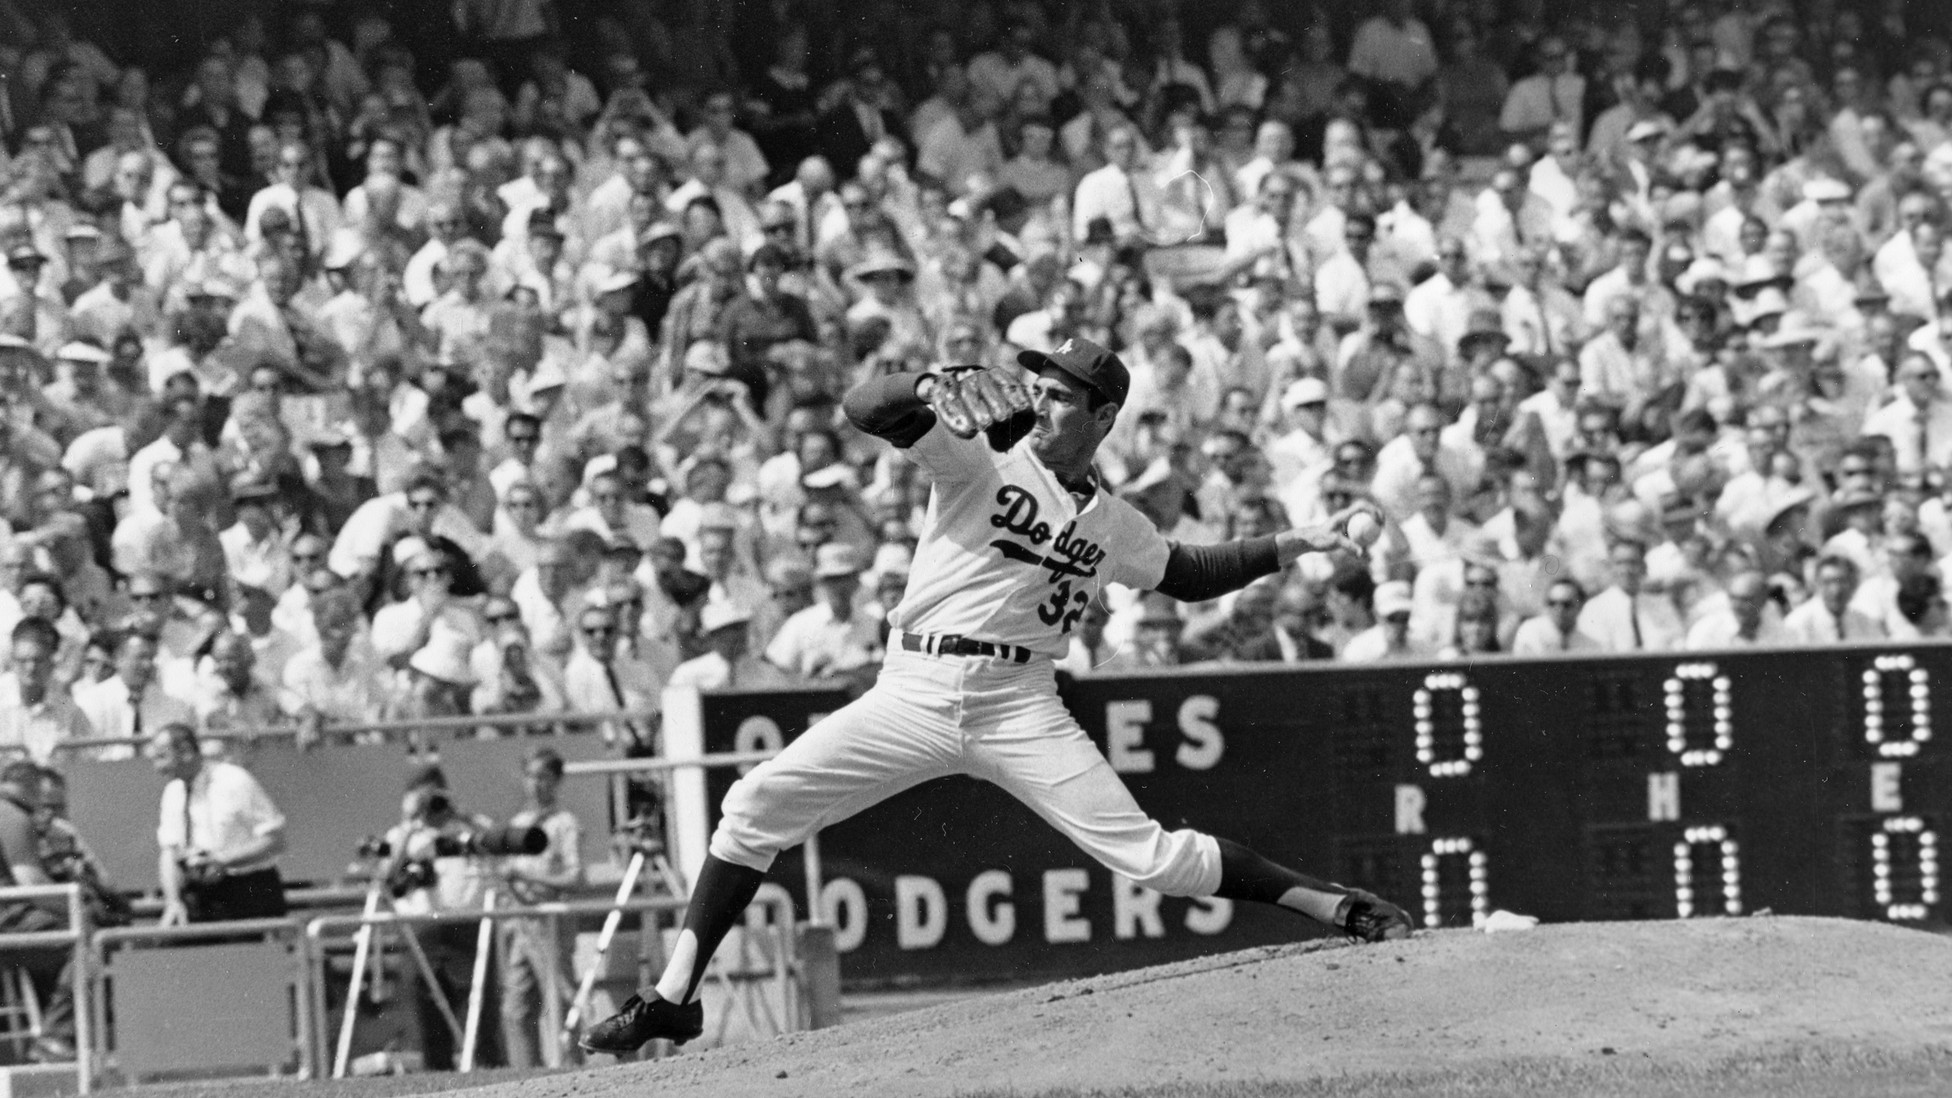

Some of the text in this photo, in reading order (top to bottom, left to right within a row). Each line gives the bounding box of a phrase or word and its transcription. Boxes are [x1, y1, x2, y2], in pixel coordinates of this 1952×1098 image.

[1037, 579, 1089, 634] 32
[1412, 653, 1933, 778] 0 0 0
[1394, 761, 1904, 835] R H E
[1871, 815, 1940, 921] 0
